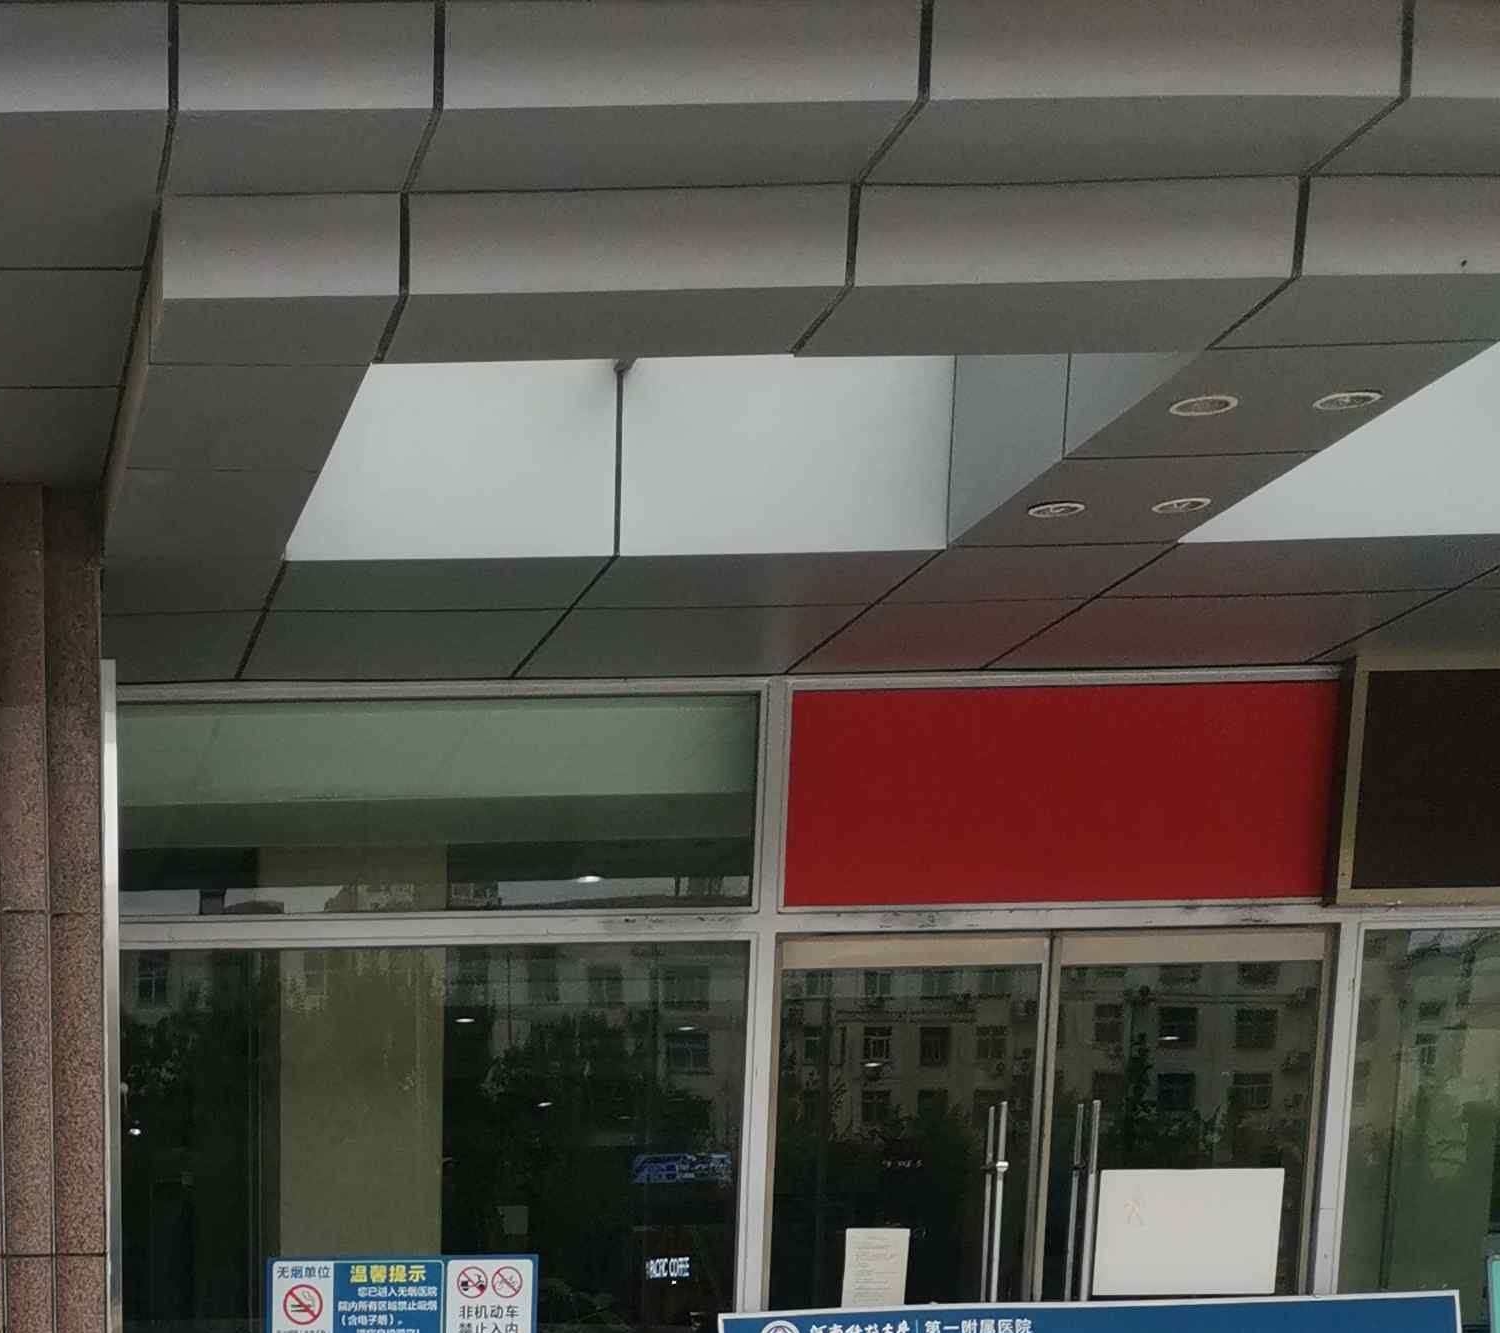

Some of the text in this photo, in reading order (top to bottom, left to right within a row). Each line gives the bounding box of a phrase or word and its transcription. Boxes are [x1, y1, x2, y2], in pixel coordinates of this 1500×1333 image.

[276, 1266, 331, 1280] 无烟单位
[350, 1265, 426, 1283] 温馨提示
[459, 1305, 520, 1319] 非机动车
